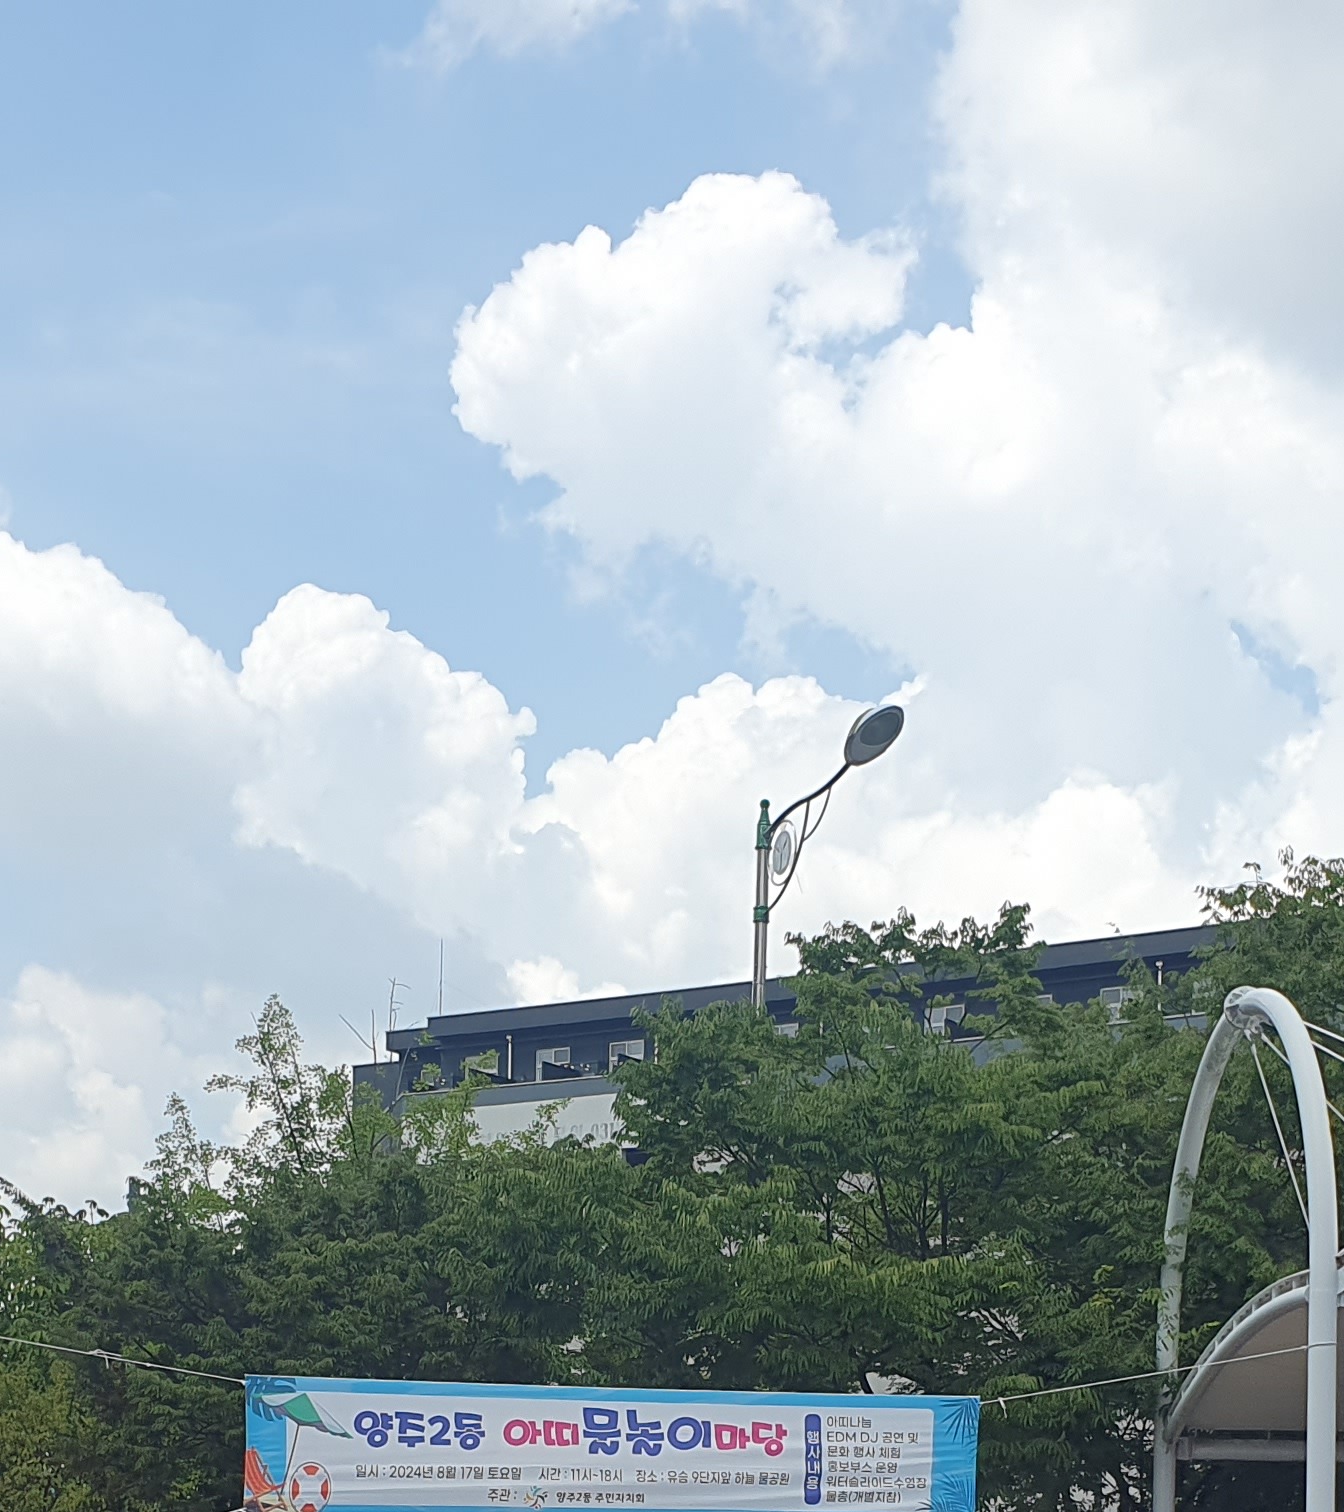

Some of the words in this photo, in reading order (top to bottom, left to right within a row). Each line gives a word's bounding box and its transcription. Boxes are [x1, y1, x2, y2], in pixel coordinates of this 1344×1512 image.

[826, 1416, 872, 1429] 아띠나눔
[353, 1410, 486, 1451] 양주2동
[826, 1431, 856, 1443] EDM
[860, 1431, 878, 1443] DJ
[882, 1431, 904, 1444] 공연
[907, 1432, 919, 1445] 및
[806, 1430, 821, 1490] 행사내용
[827, 1445, 850, 1459] 문화
[853, 1446, 876, 1459] 행사
[878, 1446, 901, 1460] 체험
[356, 1464, 380, 1479] 일시
[389, 1466, 434, 1480] 2024년
[437, 1466, 457, 1480] 8월
[460, 1467, 485, 1480] 17일
[487, 1467, 522, 1481] 토요일
[538, 1467, 562, 1482] 시간
[570, 1469, 623, 1483] 11시~18시
[828, 1461, 873, 1474] 홍보부스
[875, 1462, 898, 1474] 운영
[635, 1469, 658, 1484] 장소
[667, 1471, 689, 1485] 유승
[691, 1471, 732, 1485] 9단지앞
[487, 1489, 511, 1503] 주관
[556, 1491, 592, 1503] 양주2동
[594, 1492, 646, 1504] 주민자치회
